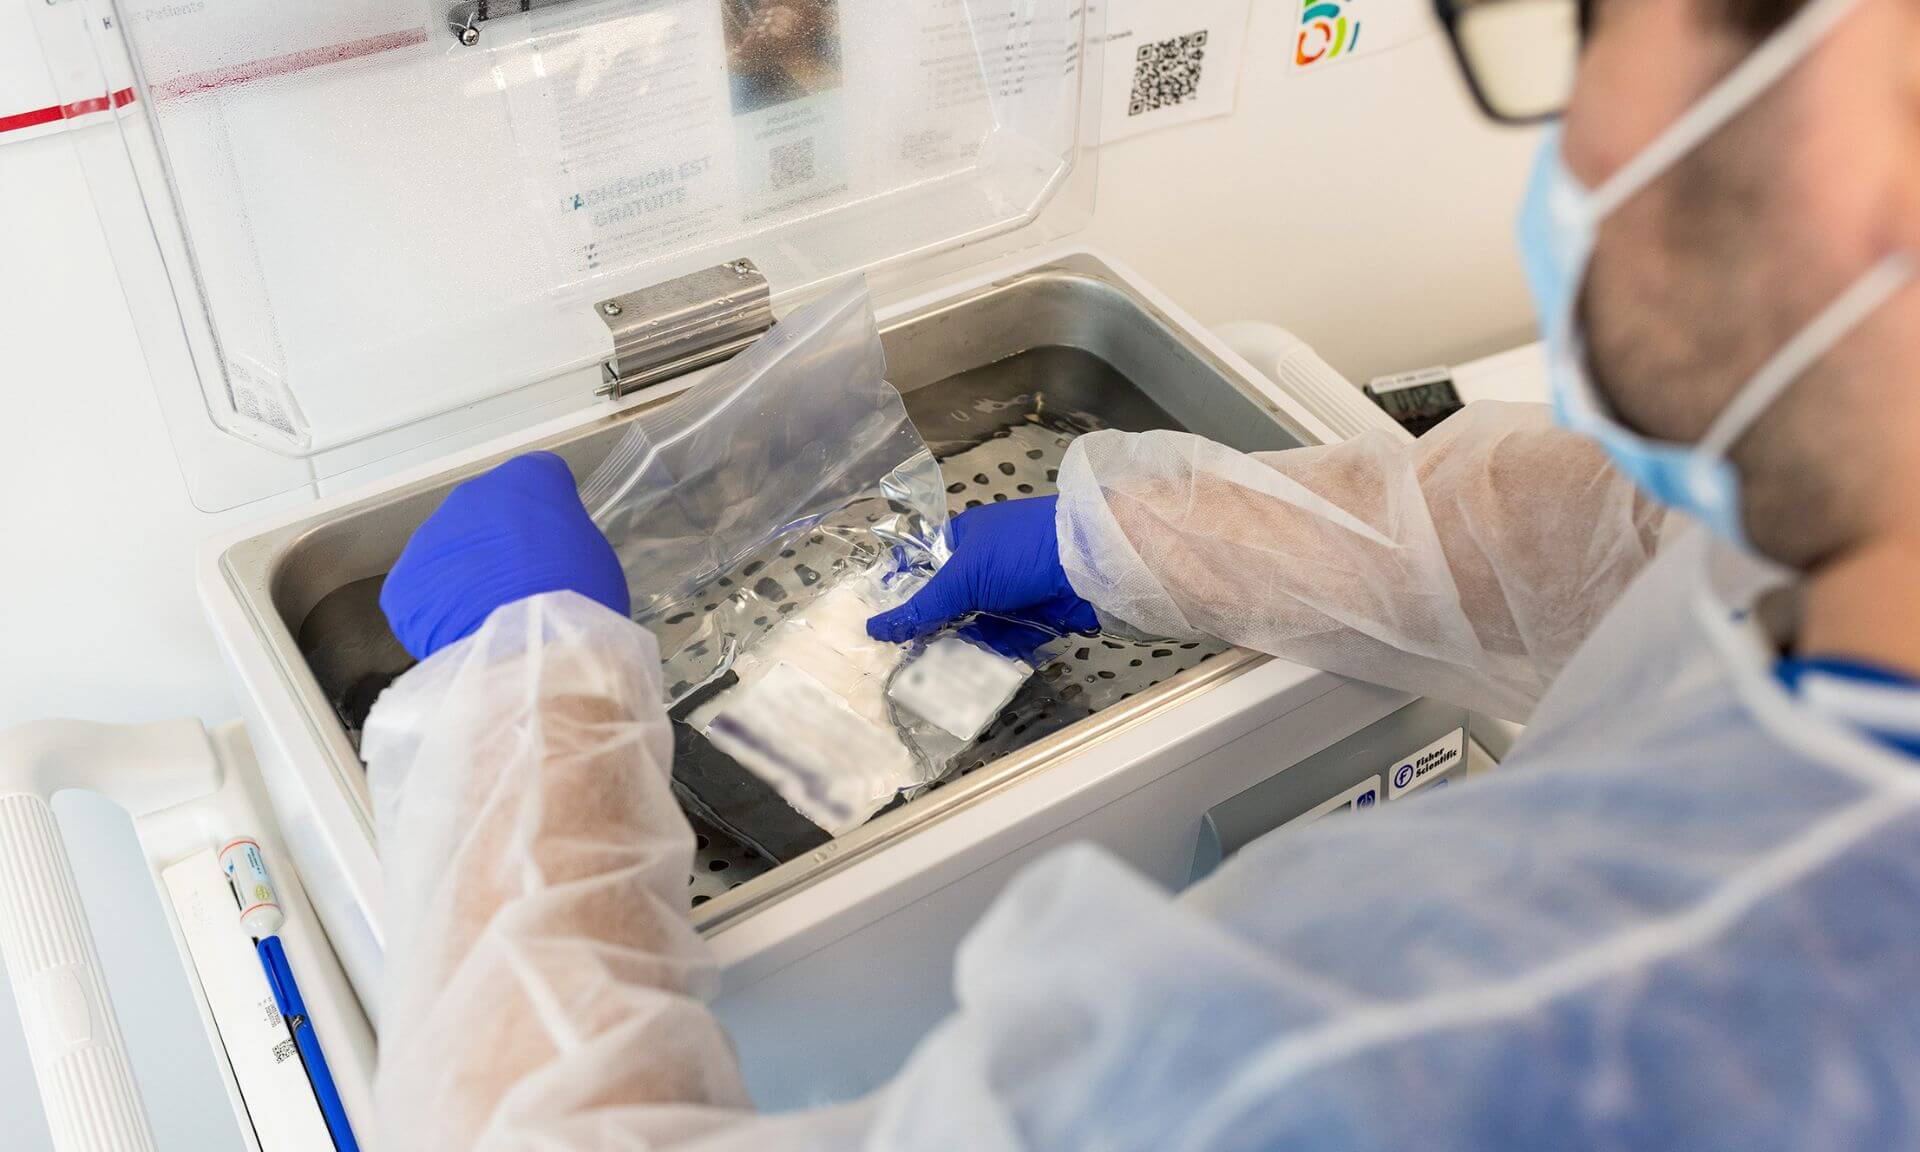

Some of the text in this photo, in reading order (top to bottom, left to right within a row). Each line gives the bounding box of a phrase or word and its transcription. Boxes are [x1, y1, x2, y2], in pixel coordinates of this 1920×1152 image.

[679, 156, 711, 178] EST
[593, 187, 686, 226] GRATUITE
[1415, 748, 1445, 769] Fisher
[1415, 749, 1458, 778] Scientific
